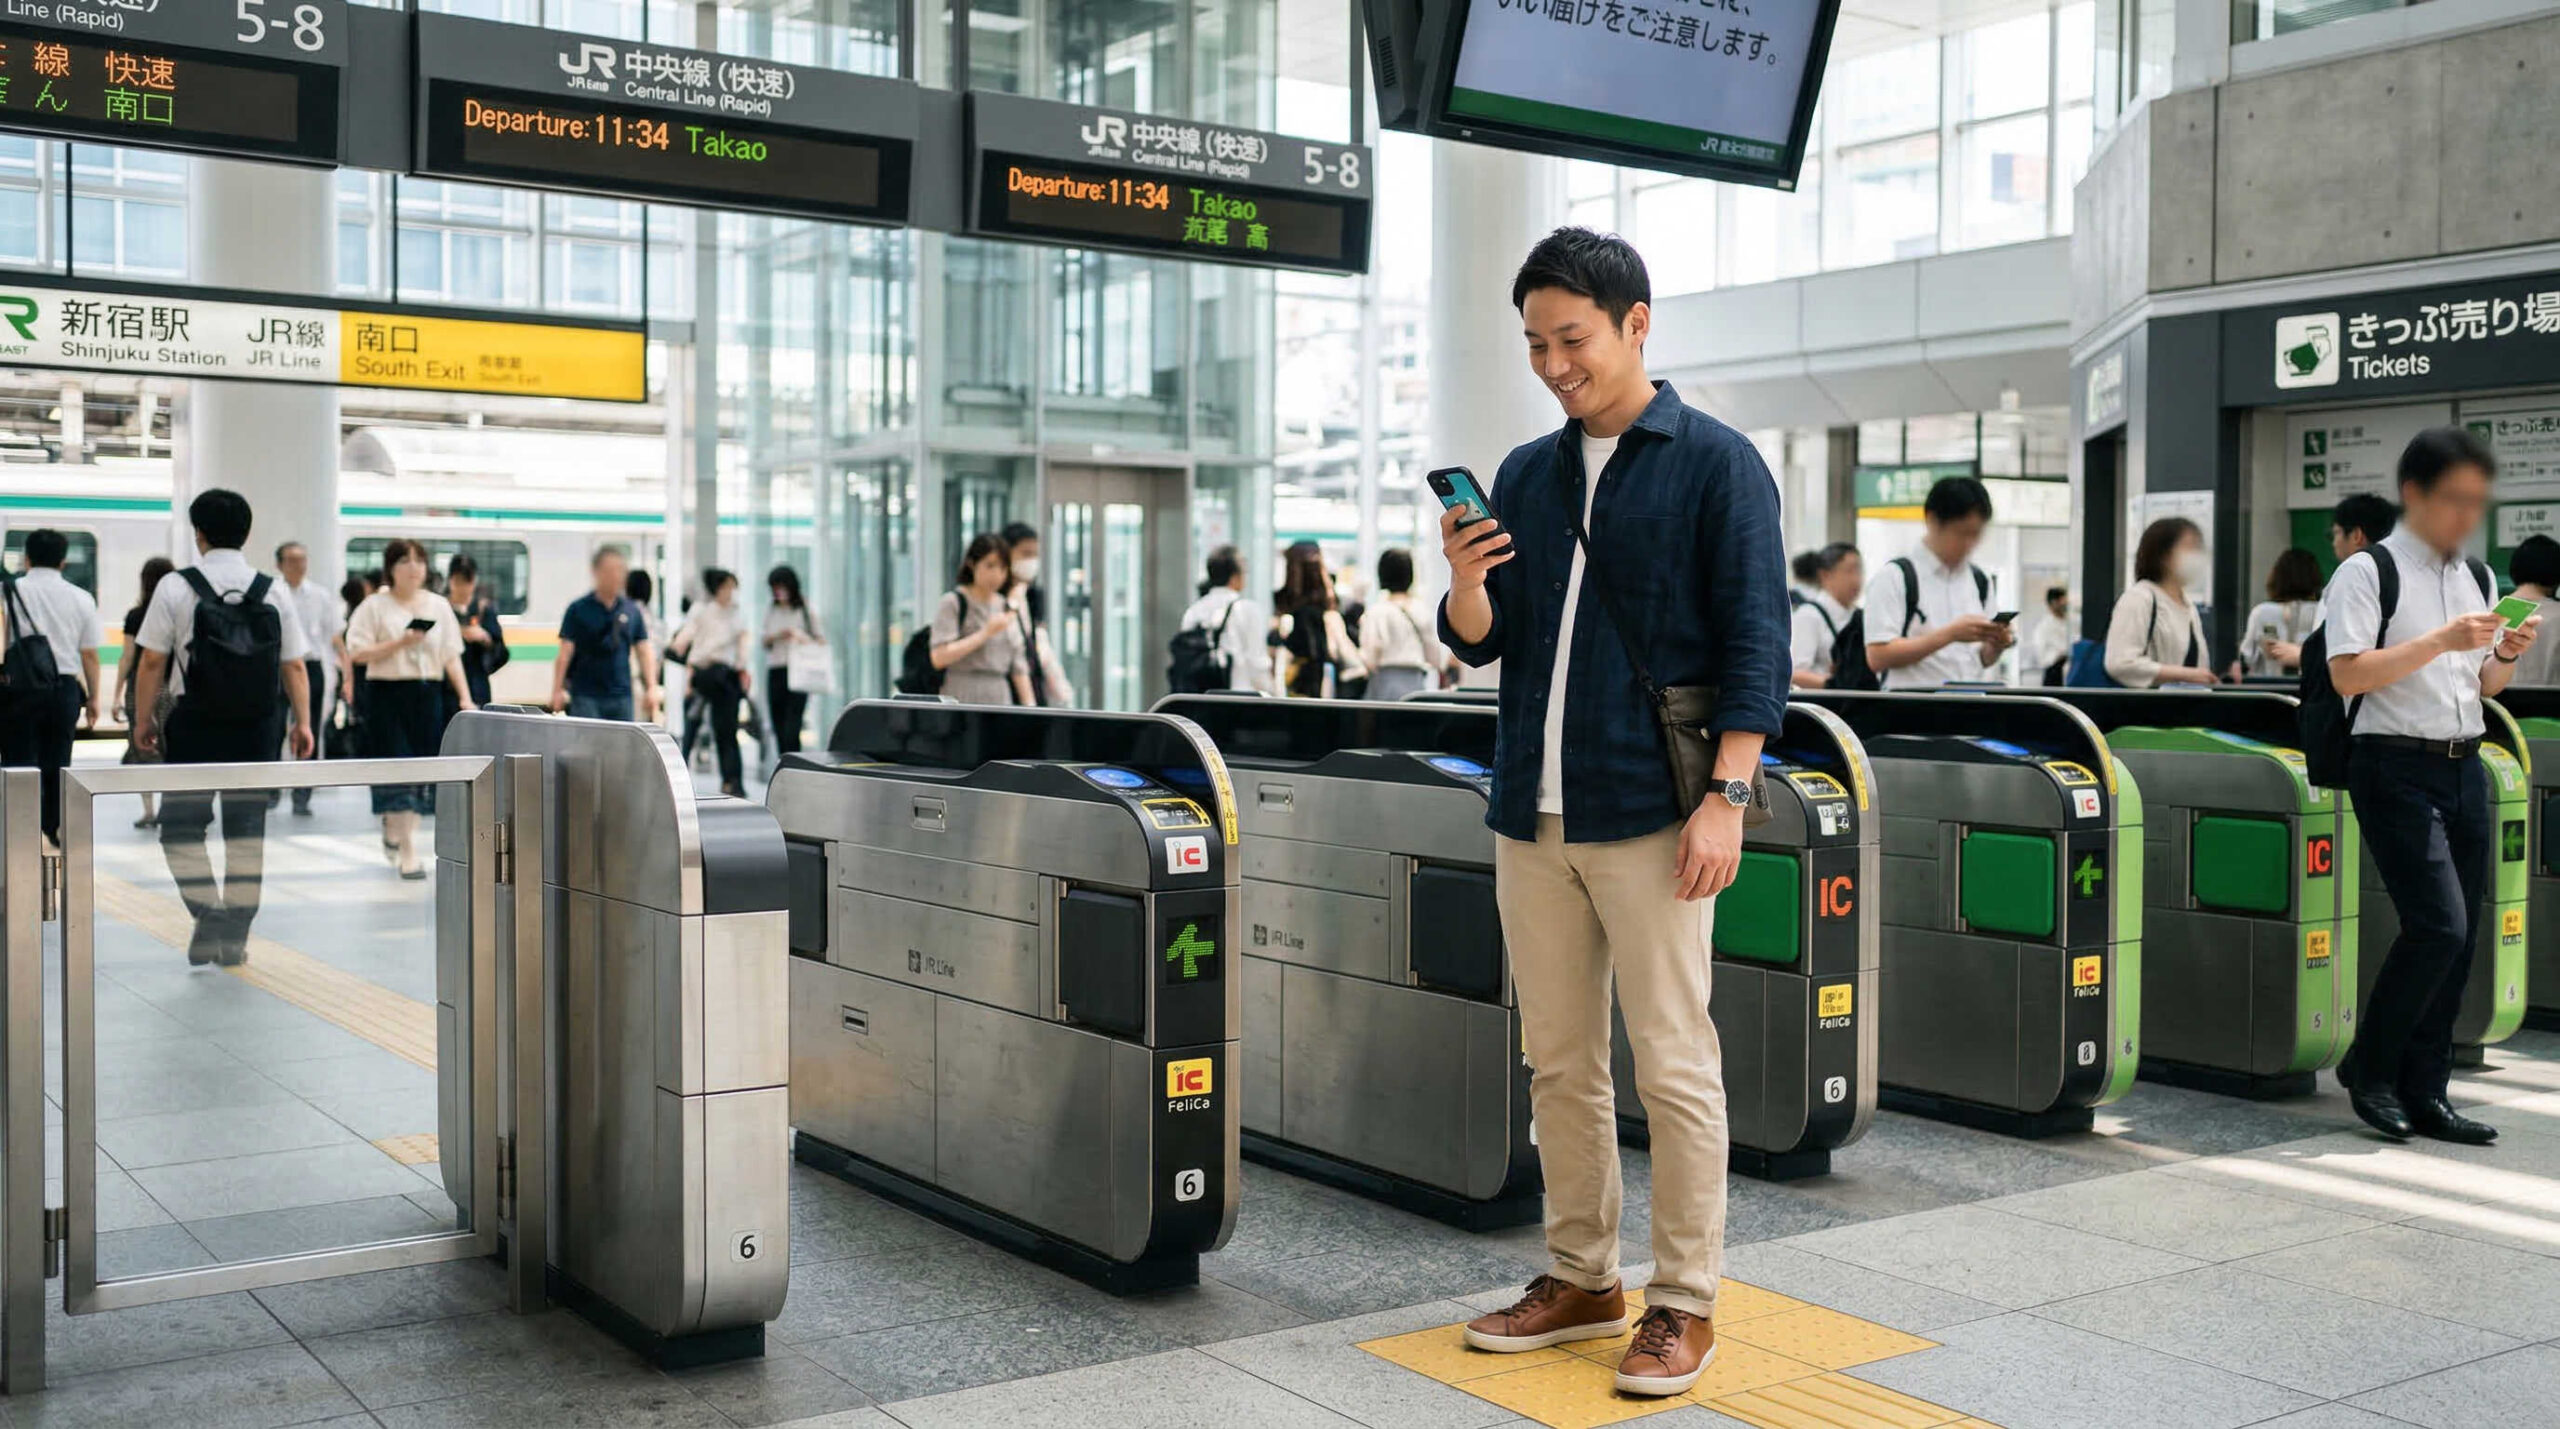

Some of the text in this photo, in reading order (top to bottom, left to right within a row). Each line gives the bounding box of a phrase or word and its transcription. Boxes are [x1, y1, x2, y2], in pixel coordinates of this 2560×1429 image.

[8, 0, 49, 18] Line
[56, 4, 124, 31] (Rapid)
[236, 0, 325, 52] 5-8
[34, 42, 70, 77] 線
[105, 50, 175, 90] 快速
[559, 42, 616, 79] JR
[35, 80, 67, 111] ん
[104, 87, 174, 126] 南口
[625, 81, 679, 102] Central
[684, 89, 716, 107] Line
[719, 94, 772, 118] (Rapid)
[685, 125, 768, 162] Takao
[1081, 115, 1127, 148] JR
[1304, 145, 1361, 189] 5-8
[1189, 188, 1257, 221] Takao
[61, 298, 190, 342] 新宿駅
[2348, 291, 2560, 349] きっぷ売り場
[61, 341, 226, 367] Shinjuku Station
[356, 323, 418, 353] 南口
[247, 350, 321, 368] JR Line
[355, 356, 418, 379] South
[427, 360, 465, 381] Exit
[2348, 353, 2430, 380] Tickets
[2308, 840, 2331, 874] IC
[1820, 876, 1853, 917] IC
[1168, 1098, 1210, 1113] FeliCa
[1830, 1080, 1840, 1099] 6
[1183, 1173, 1196, 1196] 6
[740, 1235, 756, 1259] 6
